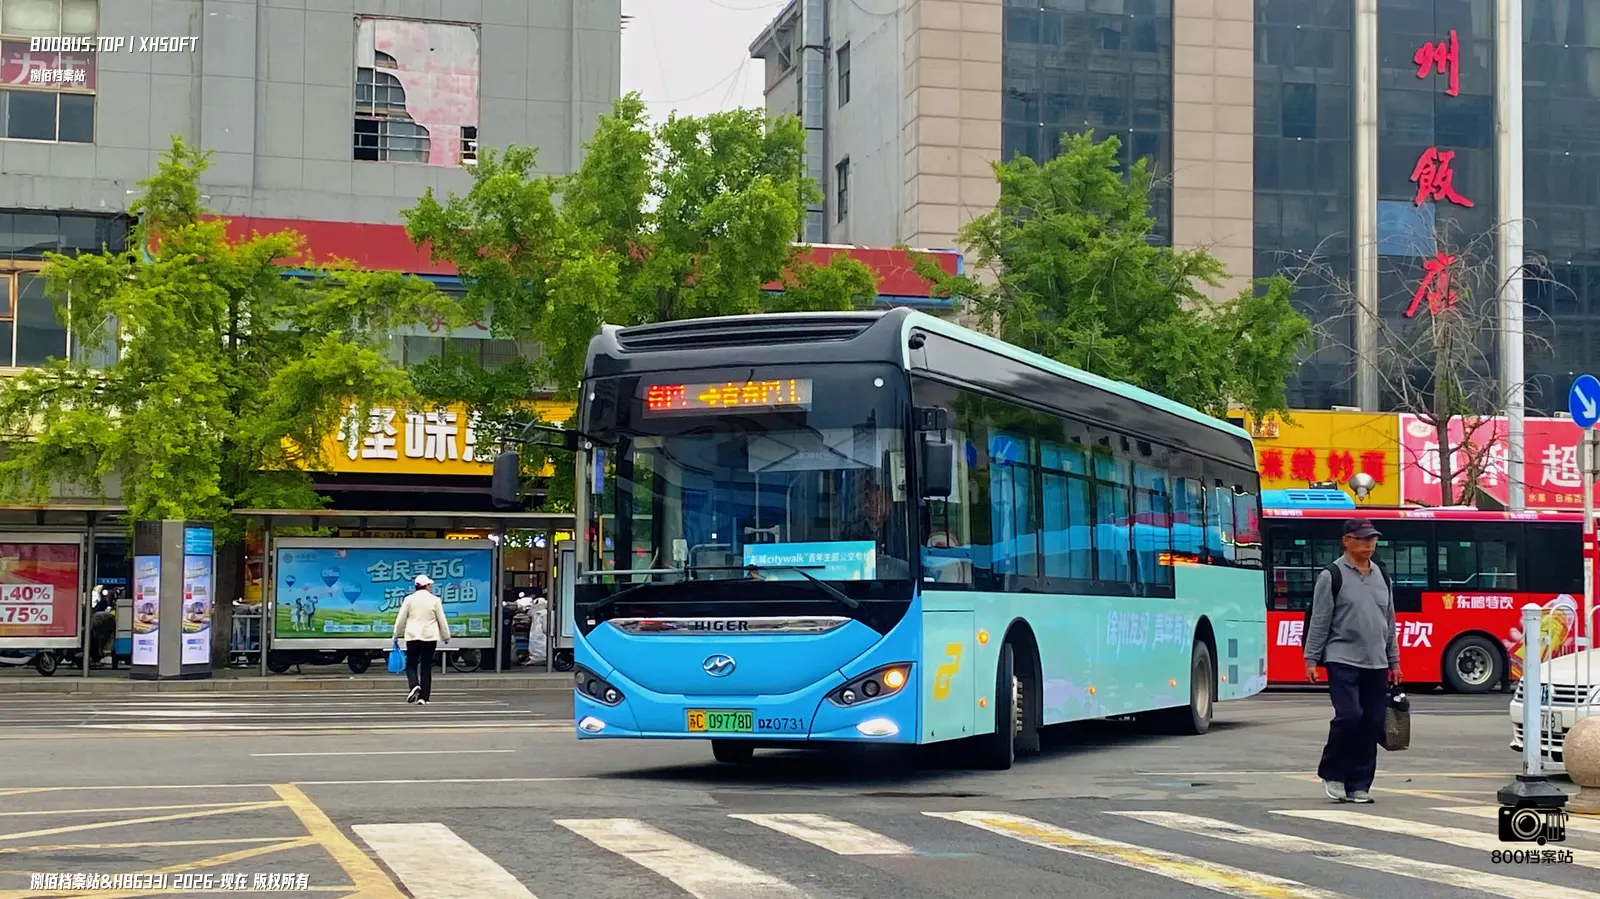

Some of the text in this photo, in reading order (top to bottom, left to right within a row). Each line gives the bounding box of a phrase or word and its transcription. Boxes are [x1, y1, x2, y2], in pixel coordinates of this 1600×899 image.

[366, 558, 464, 582] 全民享百G
[379, 582, 478, 611] 流更自由
[1456, 595, 1514, 609] 东鹏特饮
[694, 620, 749, 631] HIGER
[1395, 620, 1433, 648] 饮
[708, 713, 752, 730] 09778D
[758, 717, 805, 731] DZ0731
